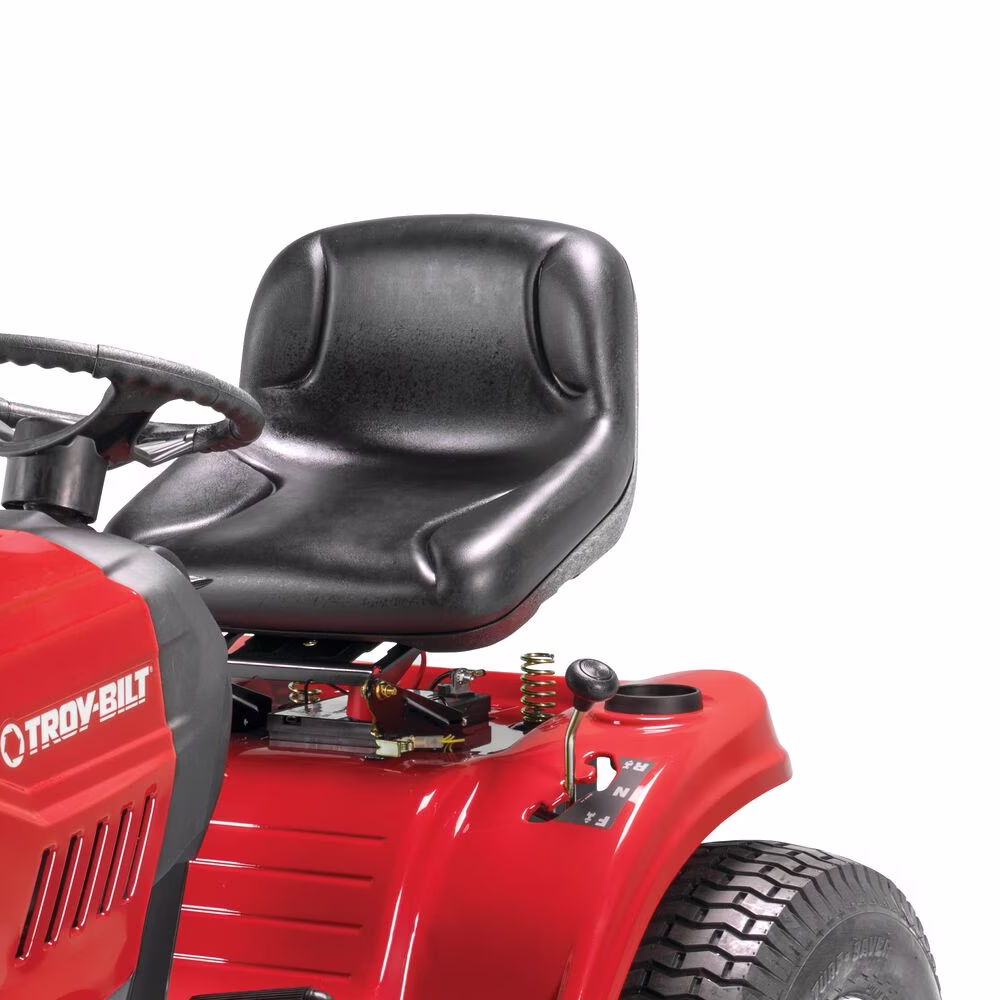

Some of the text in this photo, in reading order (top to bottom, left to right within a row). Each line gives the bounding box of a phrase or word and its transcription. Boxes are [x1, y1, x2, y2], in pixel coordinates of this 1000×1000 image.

[24, 665, 150, 756] TROY-BILT
[632, 761, 651, 773] R
[611, 785, 631, 798] N
[594, 815, 611, 828] F
